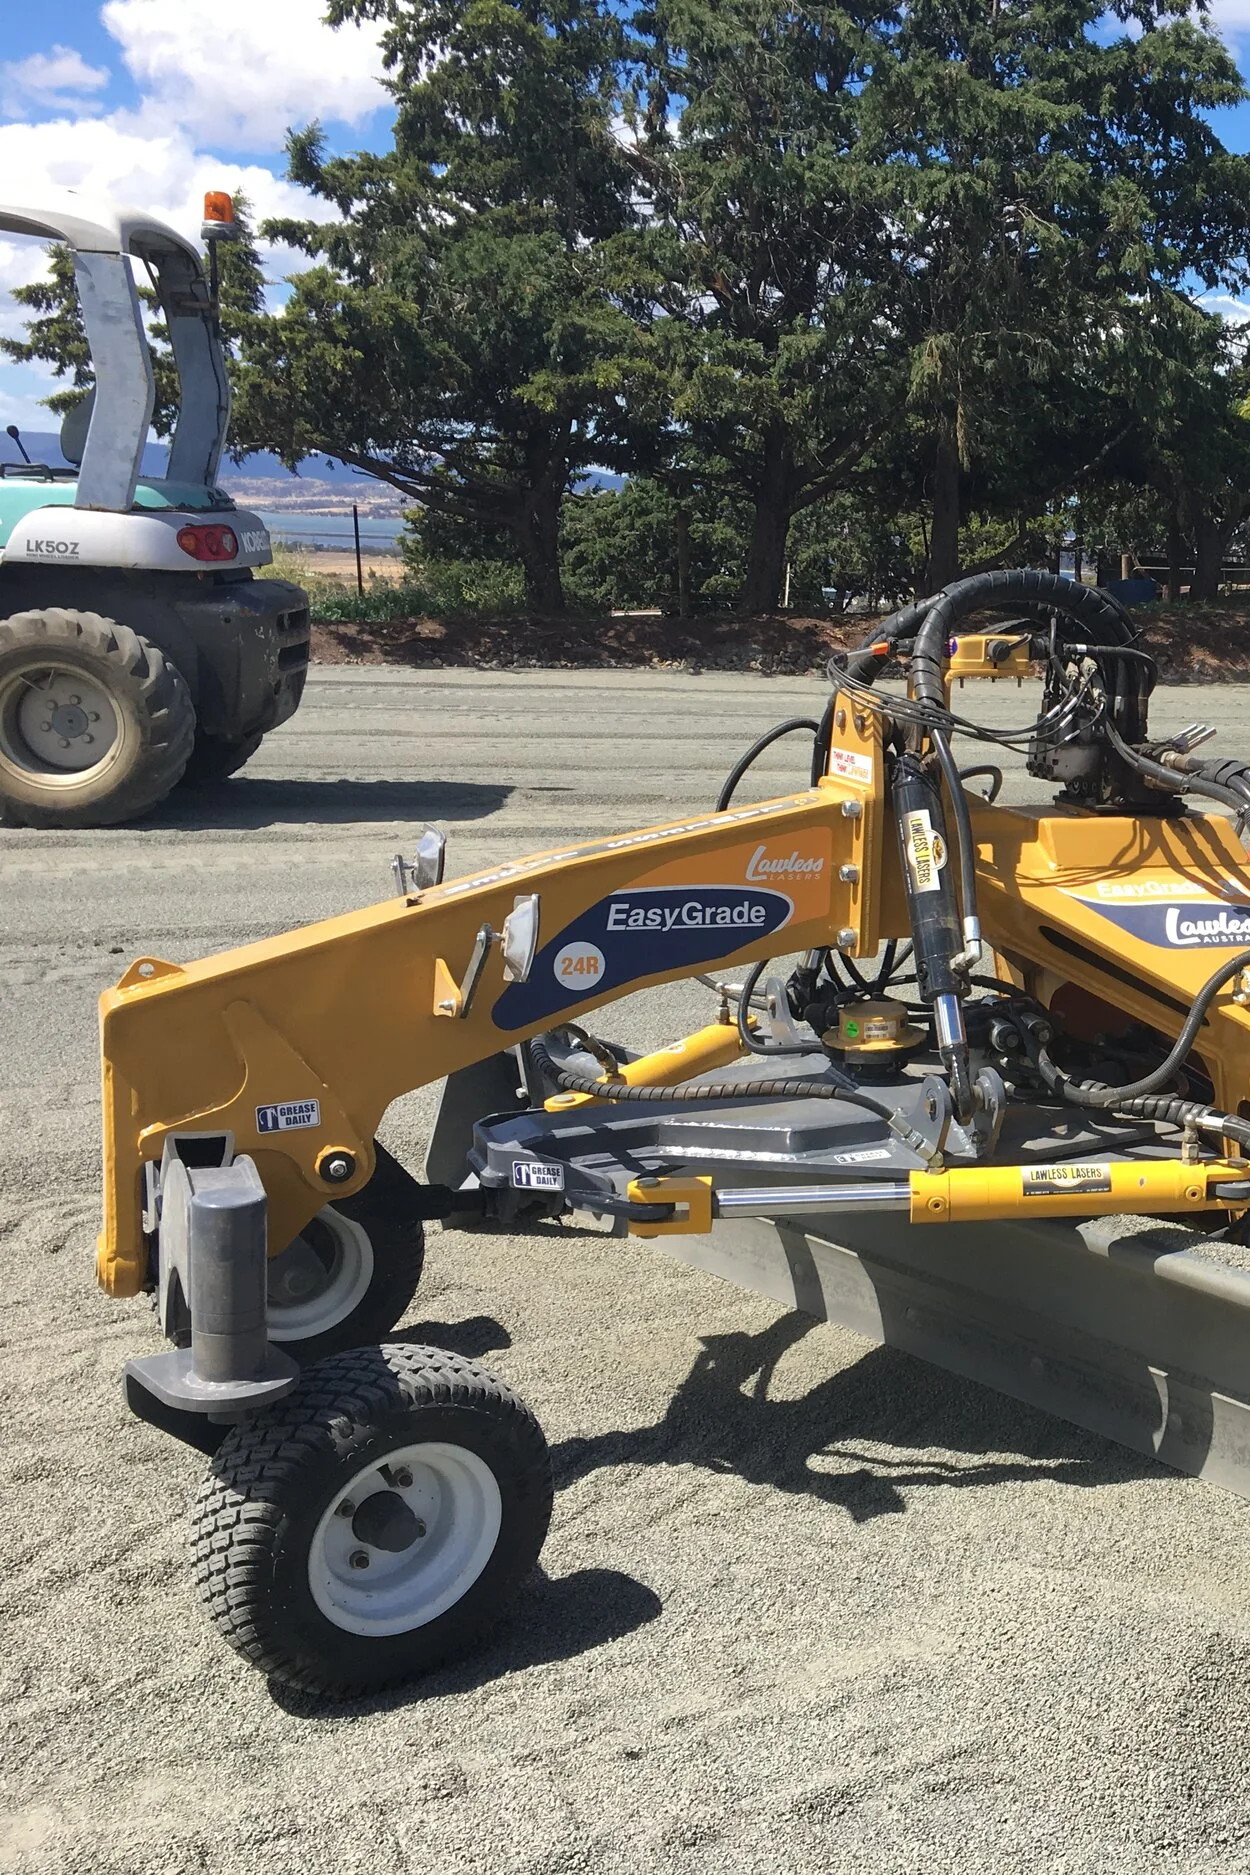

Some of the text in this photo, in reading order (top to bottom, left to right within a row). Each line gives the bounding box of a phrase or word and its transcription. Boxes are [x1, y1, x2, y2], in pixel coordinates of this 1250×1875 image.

[909, 818, 931, 884] LAWLESS LASERS
[745, 845, 825, 881] Lawless
[769, 873, 822, 881] LASERS
[1096, 880, 1207, 897] EasyGrade
[606, 901, 767, 933] EasyGrade
[560, 956, 600, 976] 24R
[280, 1103, 316, 1117] GREASE
[285, 1113, 312, 1126] DAILY
[531, 1166, 561, 1177] GREASE
[1030, 1167, 1102, 1181] LAWLESS LASERS
[536, 1176, 557, 1186] DAILY
